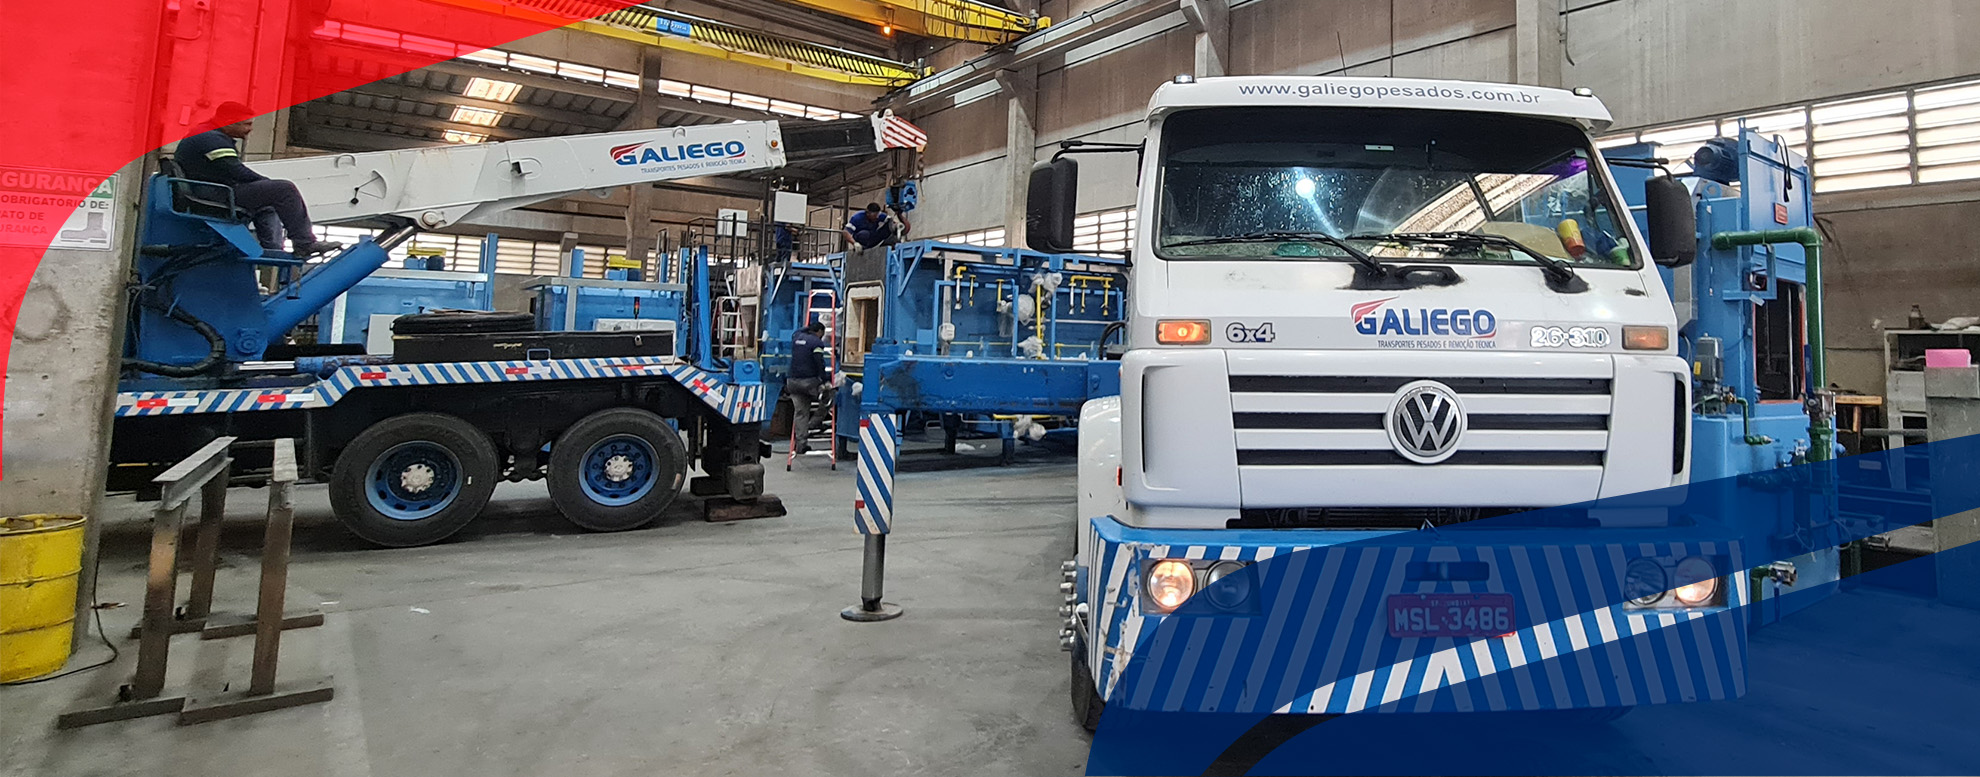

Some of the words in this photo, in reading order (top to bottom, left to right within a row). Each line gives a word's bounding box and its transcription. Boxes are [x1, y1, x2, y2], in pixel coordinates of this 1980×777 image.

[1238, 82, 1540, 104] www.galiegopesados.com.br
[610, 140, 746, 166] GALIEGO
[0, 171, 112, 196] GURANÇA
[0, 210, 25, 220] ATO
[29, 211, 45, 221] DE
[1351, 303, 1497, 336] GALIEGO
[1226, 322, 1275, 342] 6x4
[1377, 340, 1415, 349] TRANSPORTES
[1416, 341, 1442, 349] PESADOS
[1443, 341, 1447, 349] E
